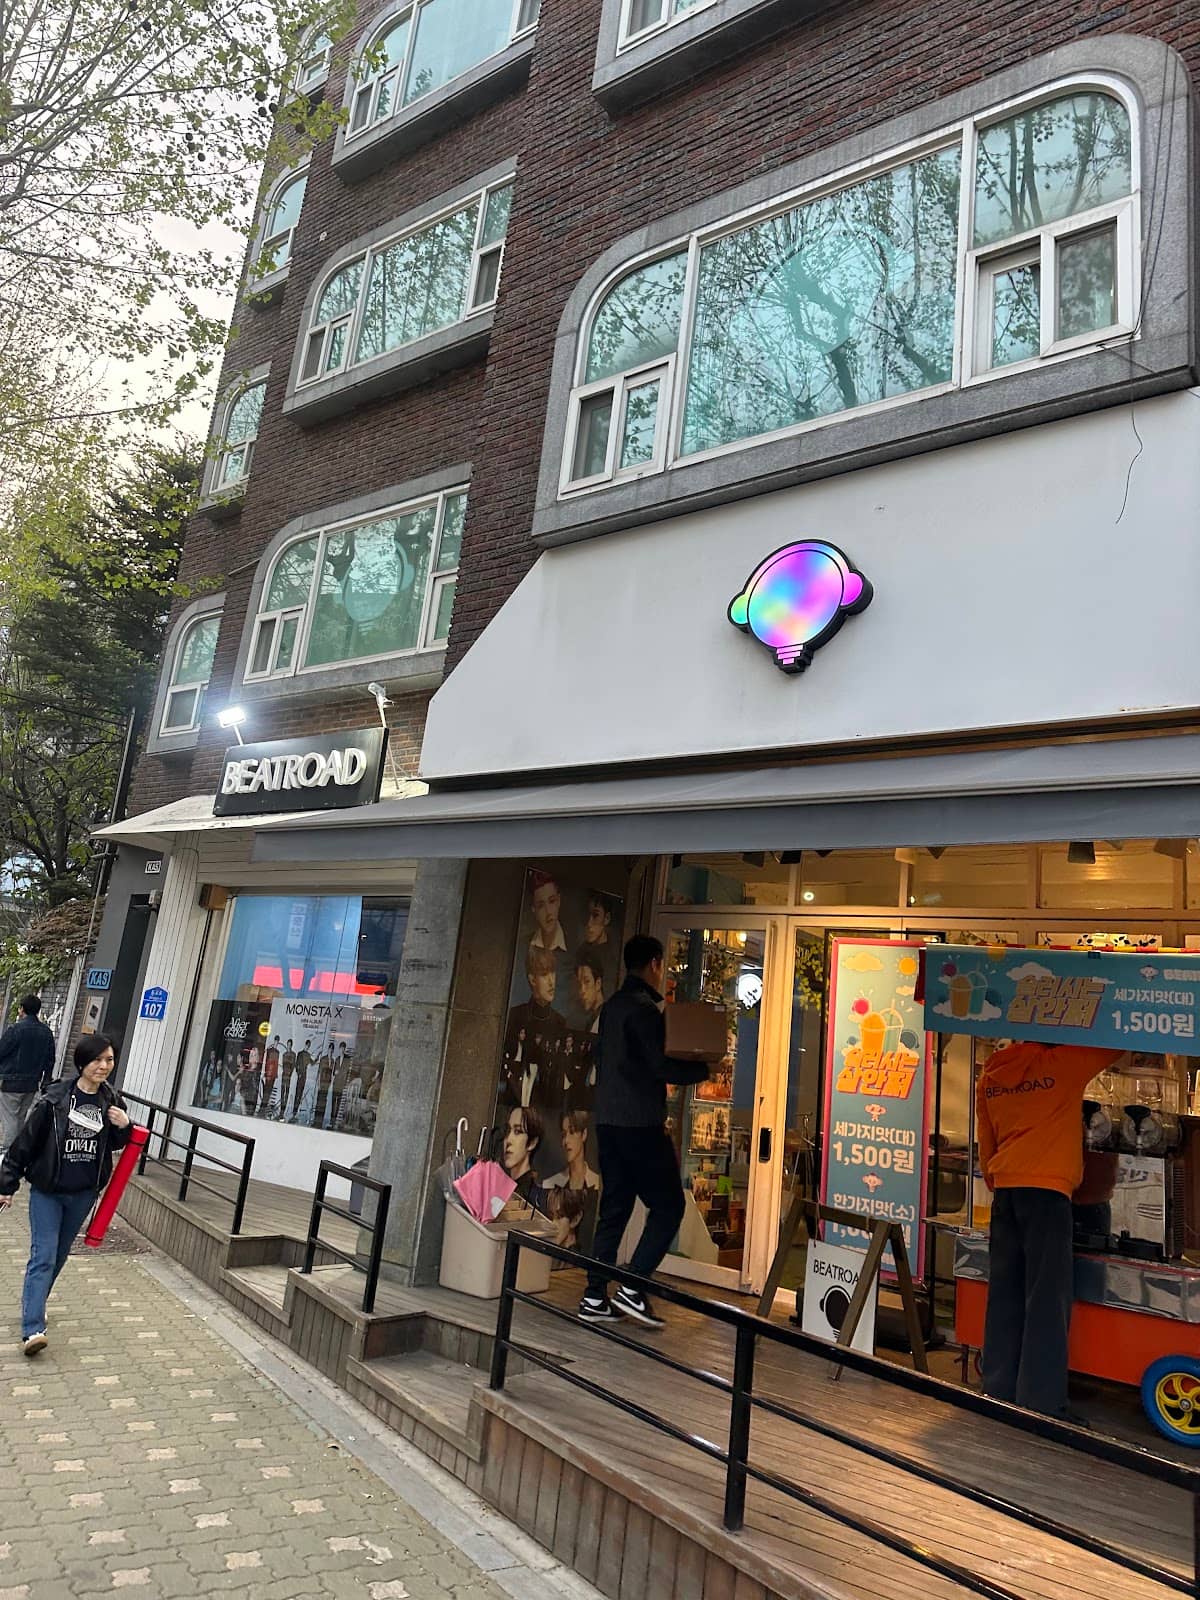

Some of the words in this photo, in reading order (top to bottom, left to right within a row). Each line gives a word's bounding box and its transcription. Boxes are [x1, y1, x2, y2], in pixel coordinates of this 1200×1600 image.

[221, 748, 367, 794] BEATROAD
[147, 863, 159, 872] KAS
[90, 973, 109, 986] KAS
[144, 1003, 163, 1016] 107
[1113, 988, 1195, 1006] 세가지맛(대)
[286, 1003, 332, 1018] MONSTA
[333, 1007, 344, 1019] X
[1111, 1010, 1195, 1038] 1,500원
[833, 1121, 916, 1147] 세가지맛(대)
[832, 1140, 915, 1174] 1,500원
[832, 1192, 915, 1221] 한가지맛(소)
[813, 1259, 860, 1285] BEATROA
